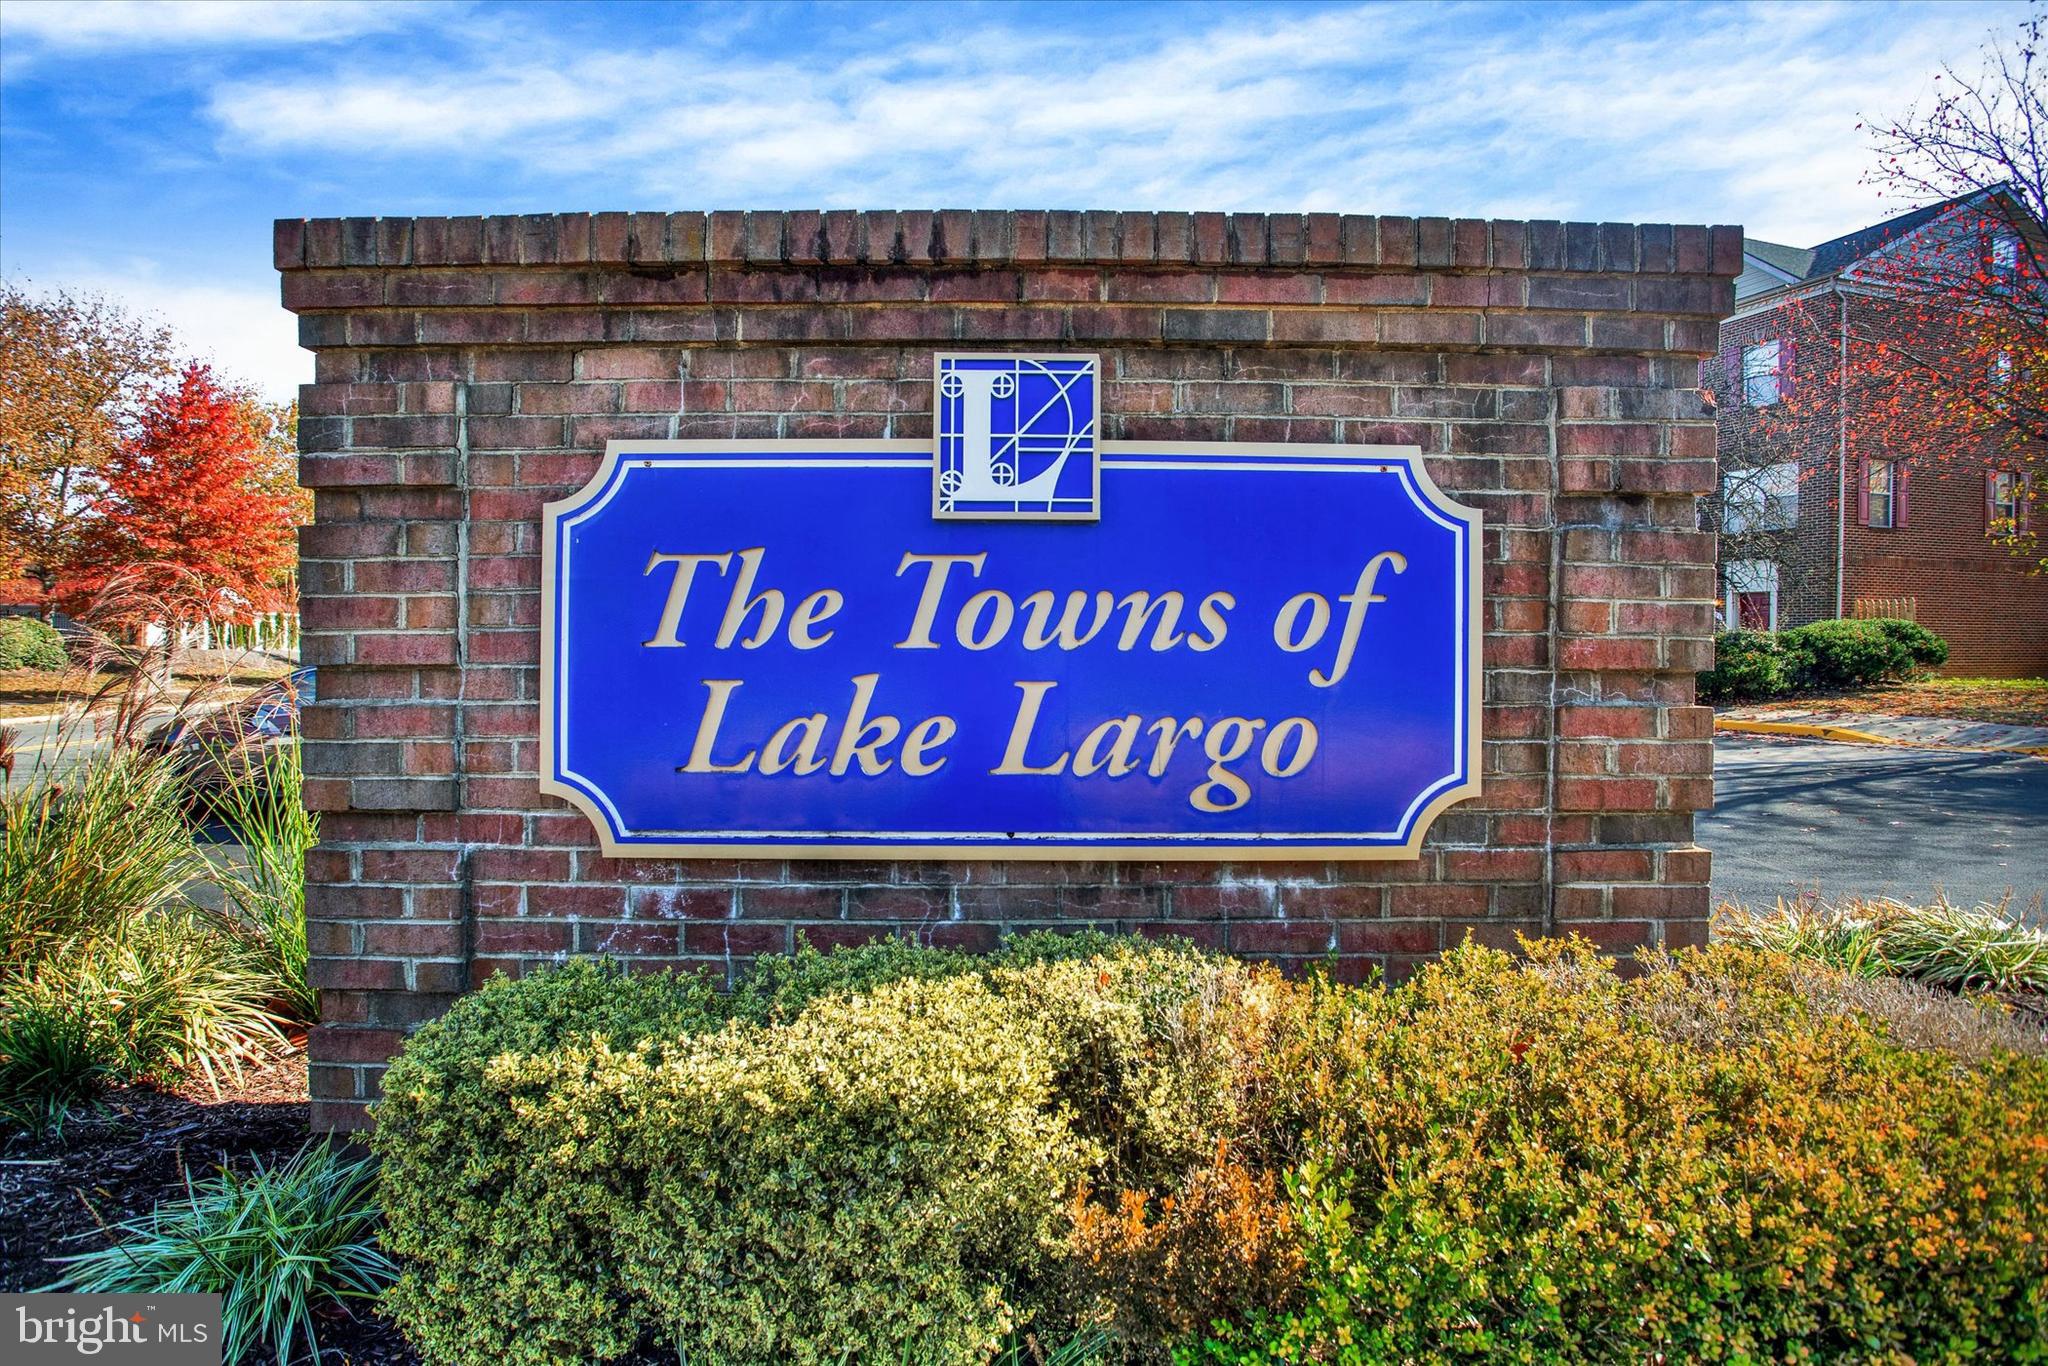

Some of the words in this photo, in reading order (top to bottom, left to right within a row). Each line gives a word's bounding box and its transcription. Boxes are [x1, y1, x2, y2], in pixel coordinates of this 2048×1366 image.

[641, 546, 844, 652] The
[894, 550, 1236, 653] Towns
[1272, 550, 1408, 688] of
[676, 673, 957, 778] Lake
[989, 679, 1320, 814] Largo
